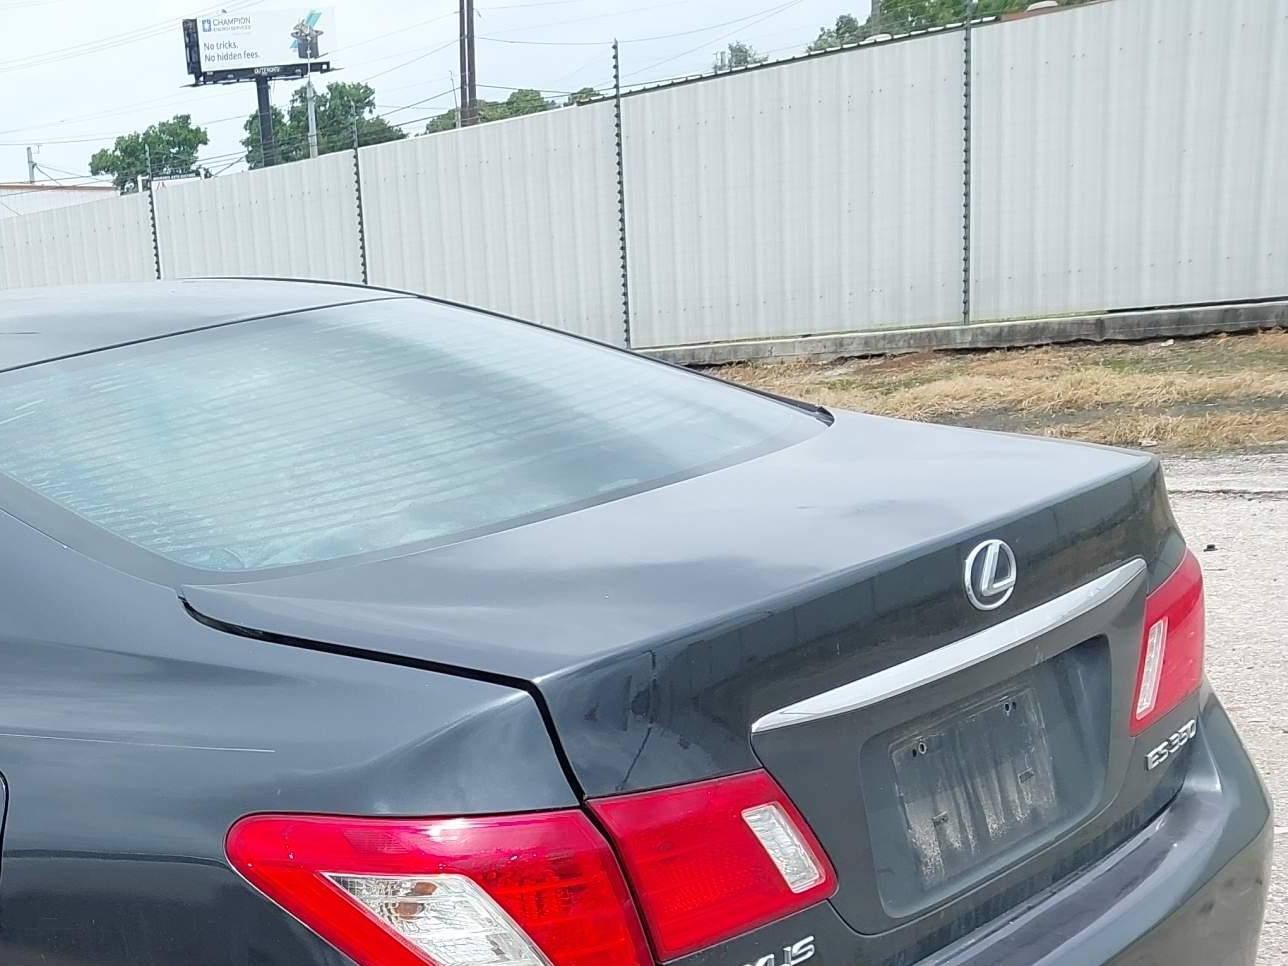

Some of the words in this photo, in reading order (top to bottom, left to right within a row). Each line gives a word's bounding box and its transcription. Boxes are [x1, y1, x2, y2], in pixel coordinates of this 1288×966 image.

[212, 16, 251, 26] CHAMPION
[203, 42, 215, 51] No
[216, 40, 239, 50] tricks.
[205, 53, 216, 62] No
[217, 51, 243, 61] hidden
[243, 50, 261, 59] fees.
